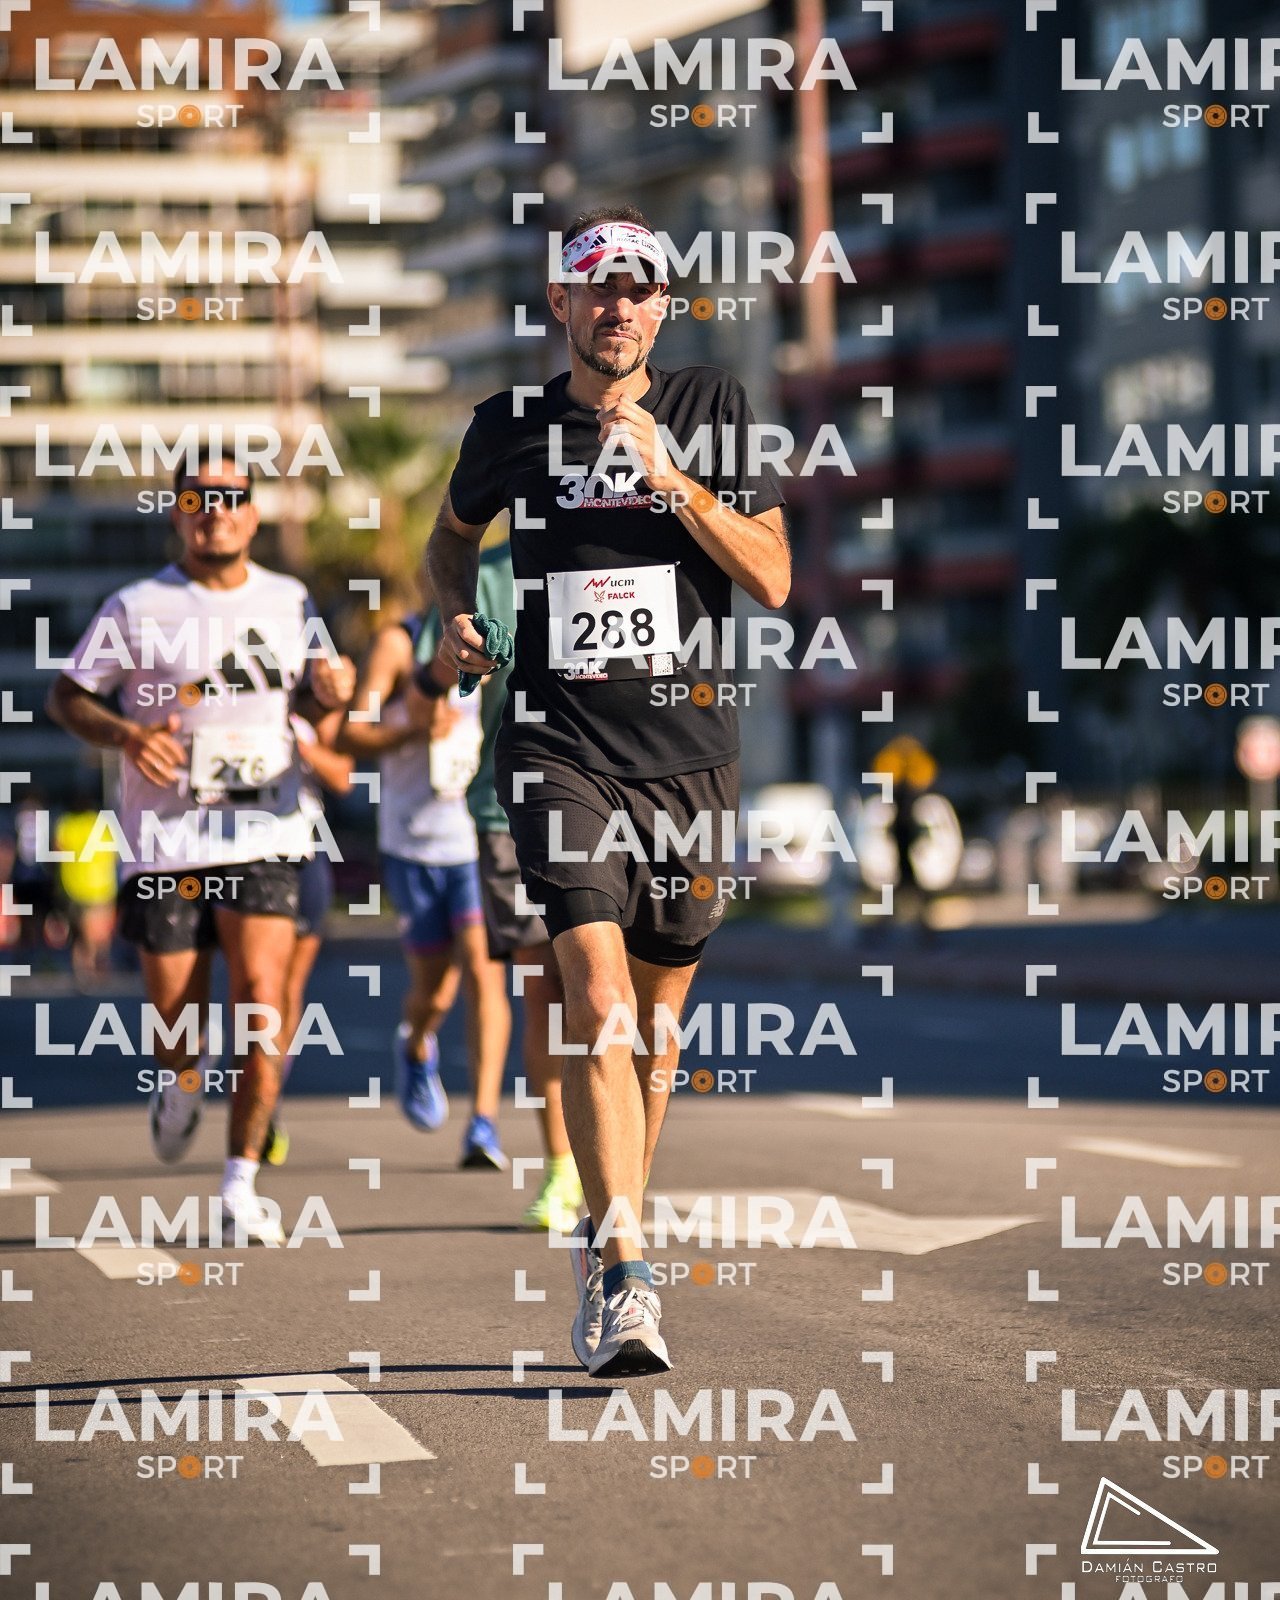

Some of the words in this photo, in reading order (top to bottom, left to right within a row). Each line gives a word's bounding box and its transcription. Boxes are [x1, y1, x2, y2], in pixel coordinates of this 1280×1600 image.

[556, 473, 644, 509] 30K
[610, 579, 635, 587] ucm
[607, 591, 635, 600] FALCK
[571, 608, 655, 650] 288
